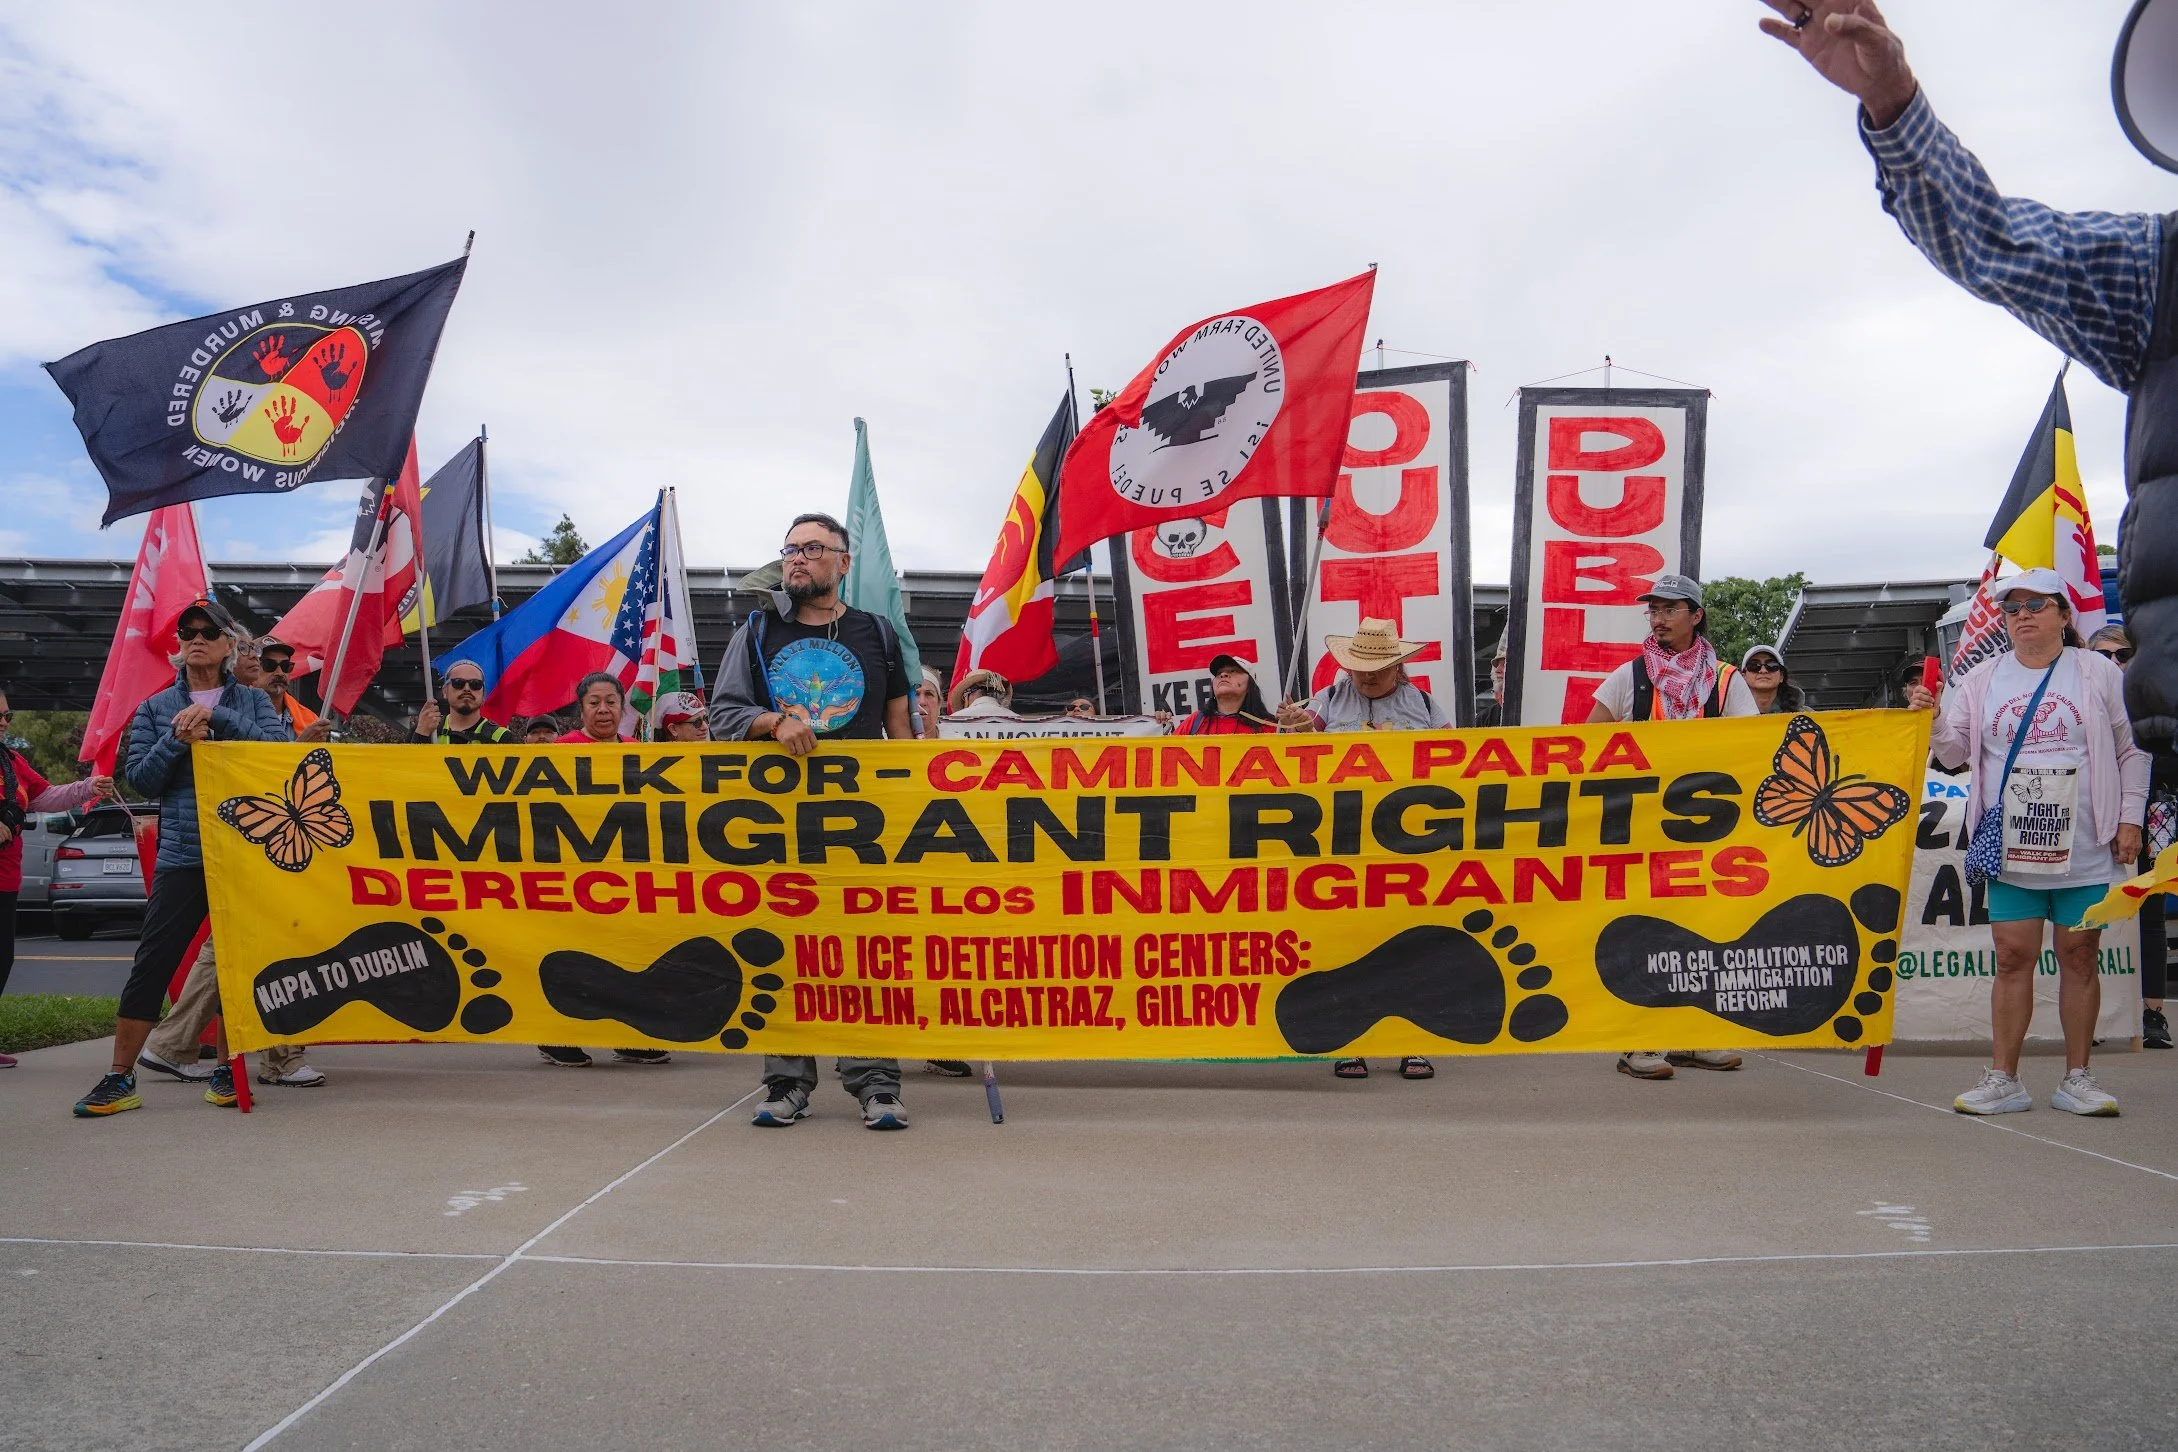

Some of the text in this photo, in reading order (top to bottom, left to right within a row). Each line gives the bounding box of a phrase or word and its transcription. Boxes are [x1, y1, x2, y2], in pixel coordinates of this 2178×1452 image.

[1132, 506, 1258, 674] CE
[2056, 694, 2083, 726] CALIFORNIA
[445, 754, 684, 796] WALK
[701, 754, 860, 796] FOR
[927, 743, 1393, 793] CAMINATA
[1411, 731, 1652, 780] PARA
[369, 771, 1742, 866] IMMIGRANT RIGHTS
[2026, 803, 2060, 818] FIGHT
[2020, 831, 2061, 846] RIGHTS
[347, 846, 1770, 917] DERECHOS DE LOS INMIGRANTES
[256, 940, 429, 1014] NAPA TO DUBLIN
[795, 928, 1312, 981] NO ICE DETENTION CENTERS:
[1648, 945, 1849, 974] NOR CAL COALITION FOR
[1668, 966, 1833, 993] JUST IMMIGRATION
[795, 981, 1261, 1031] DUBLIN, ALCATRAZ, GILROY
[1716, 989, 1788, 1012] REFORM
